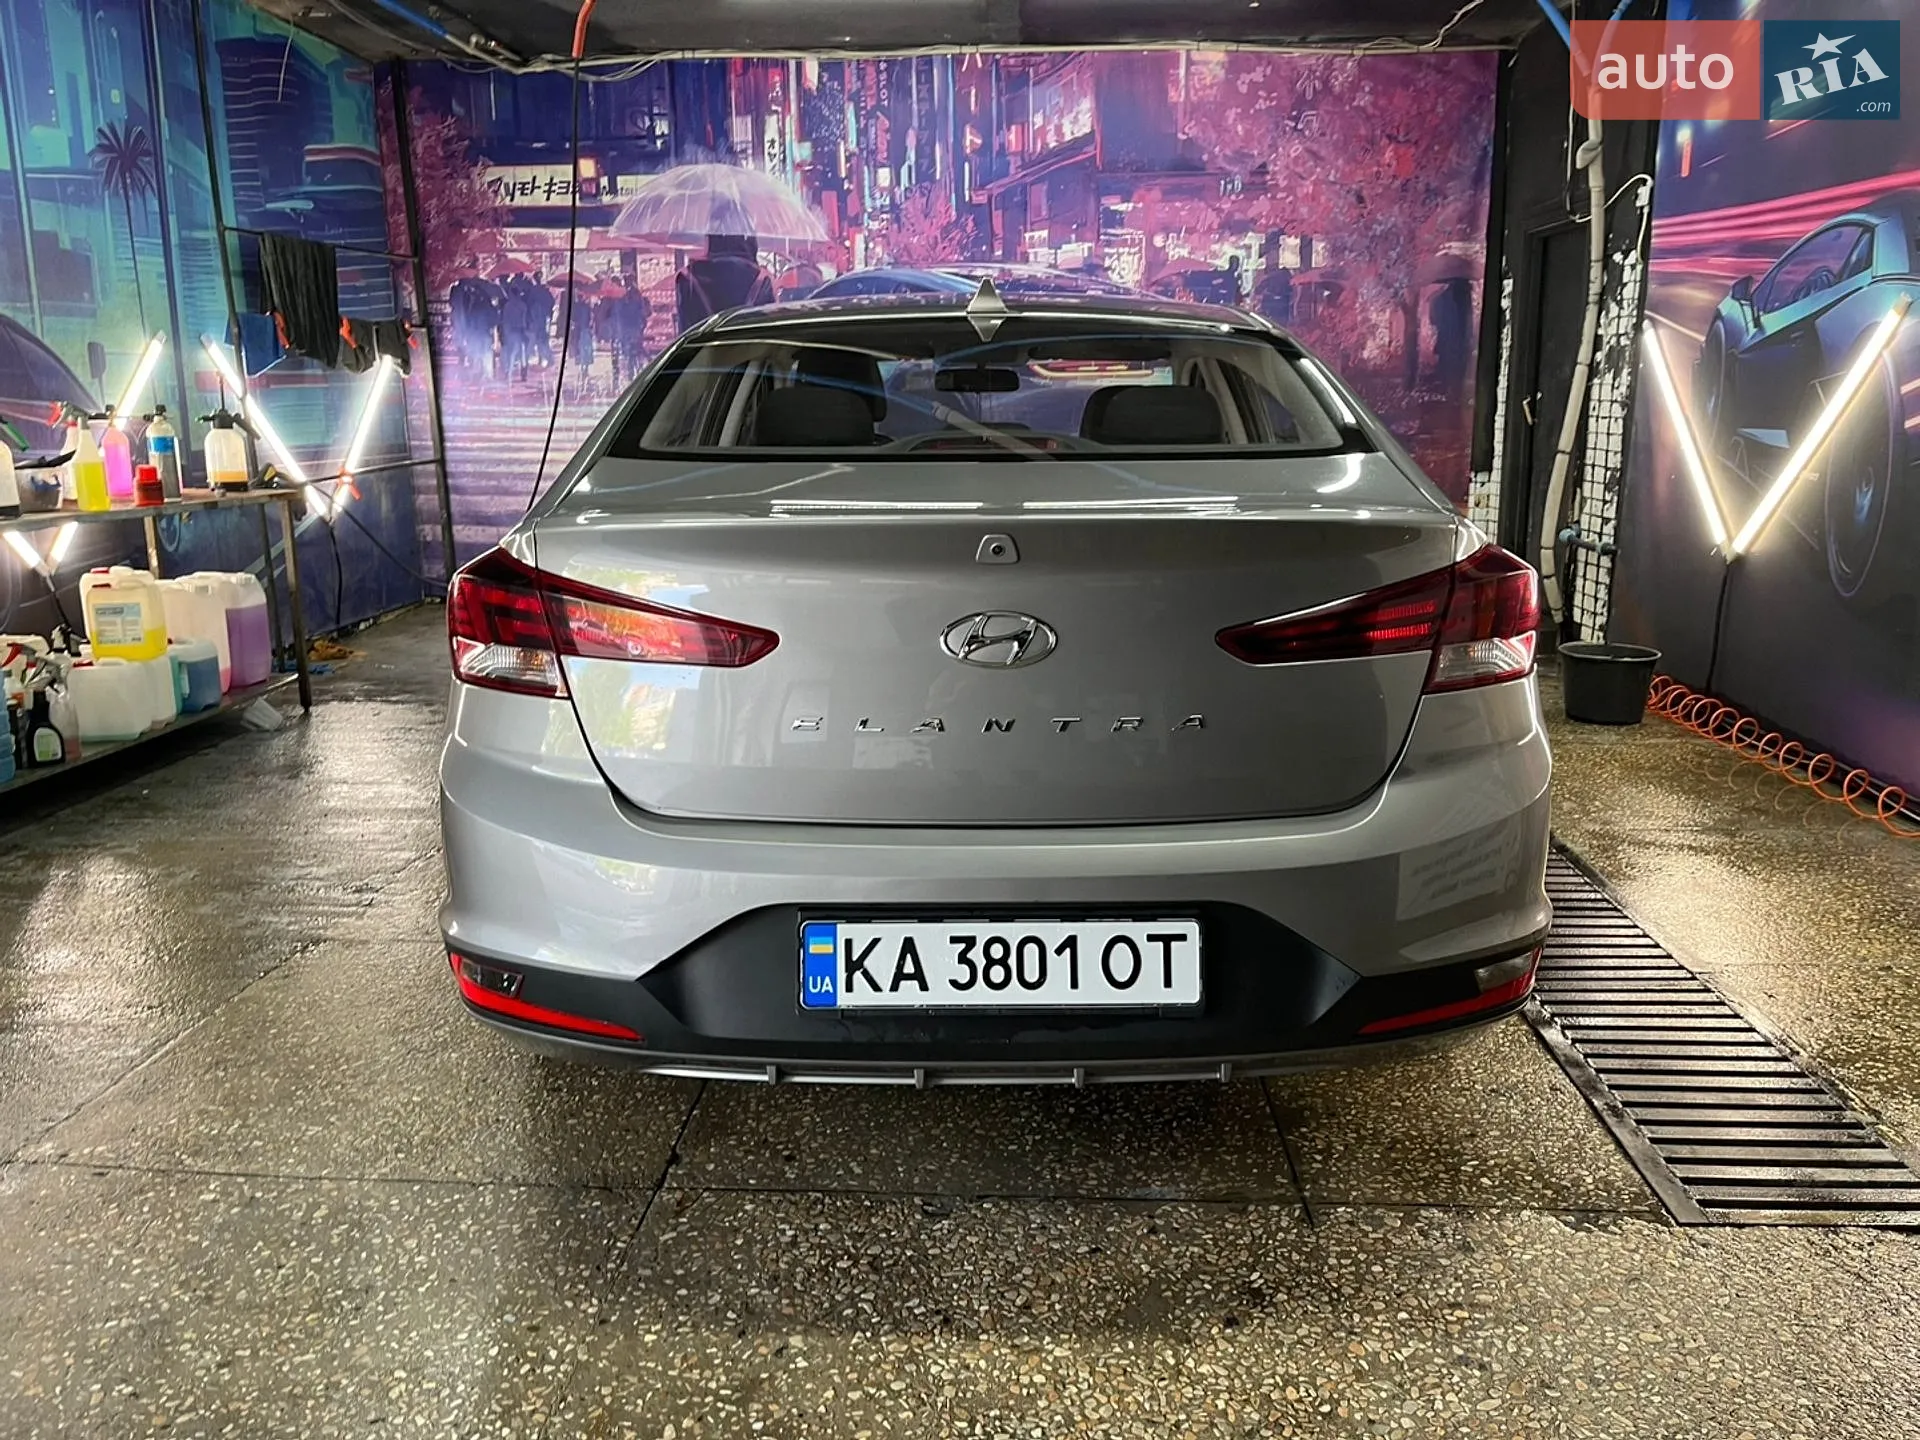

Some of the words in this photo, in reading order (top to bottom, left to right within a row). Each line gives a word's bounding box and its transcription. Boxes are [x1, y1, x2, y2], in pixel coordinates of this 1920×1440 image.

[790, 714, 1204, 733] ELANTRA
[843, 935, 930, 993] KA
[948, 933, 1080, 991] 3801
[1101, 933, 1188, 990] OT
[808, 976, 833, 994] UA
